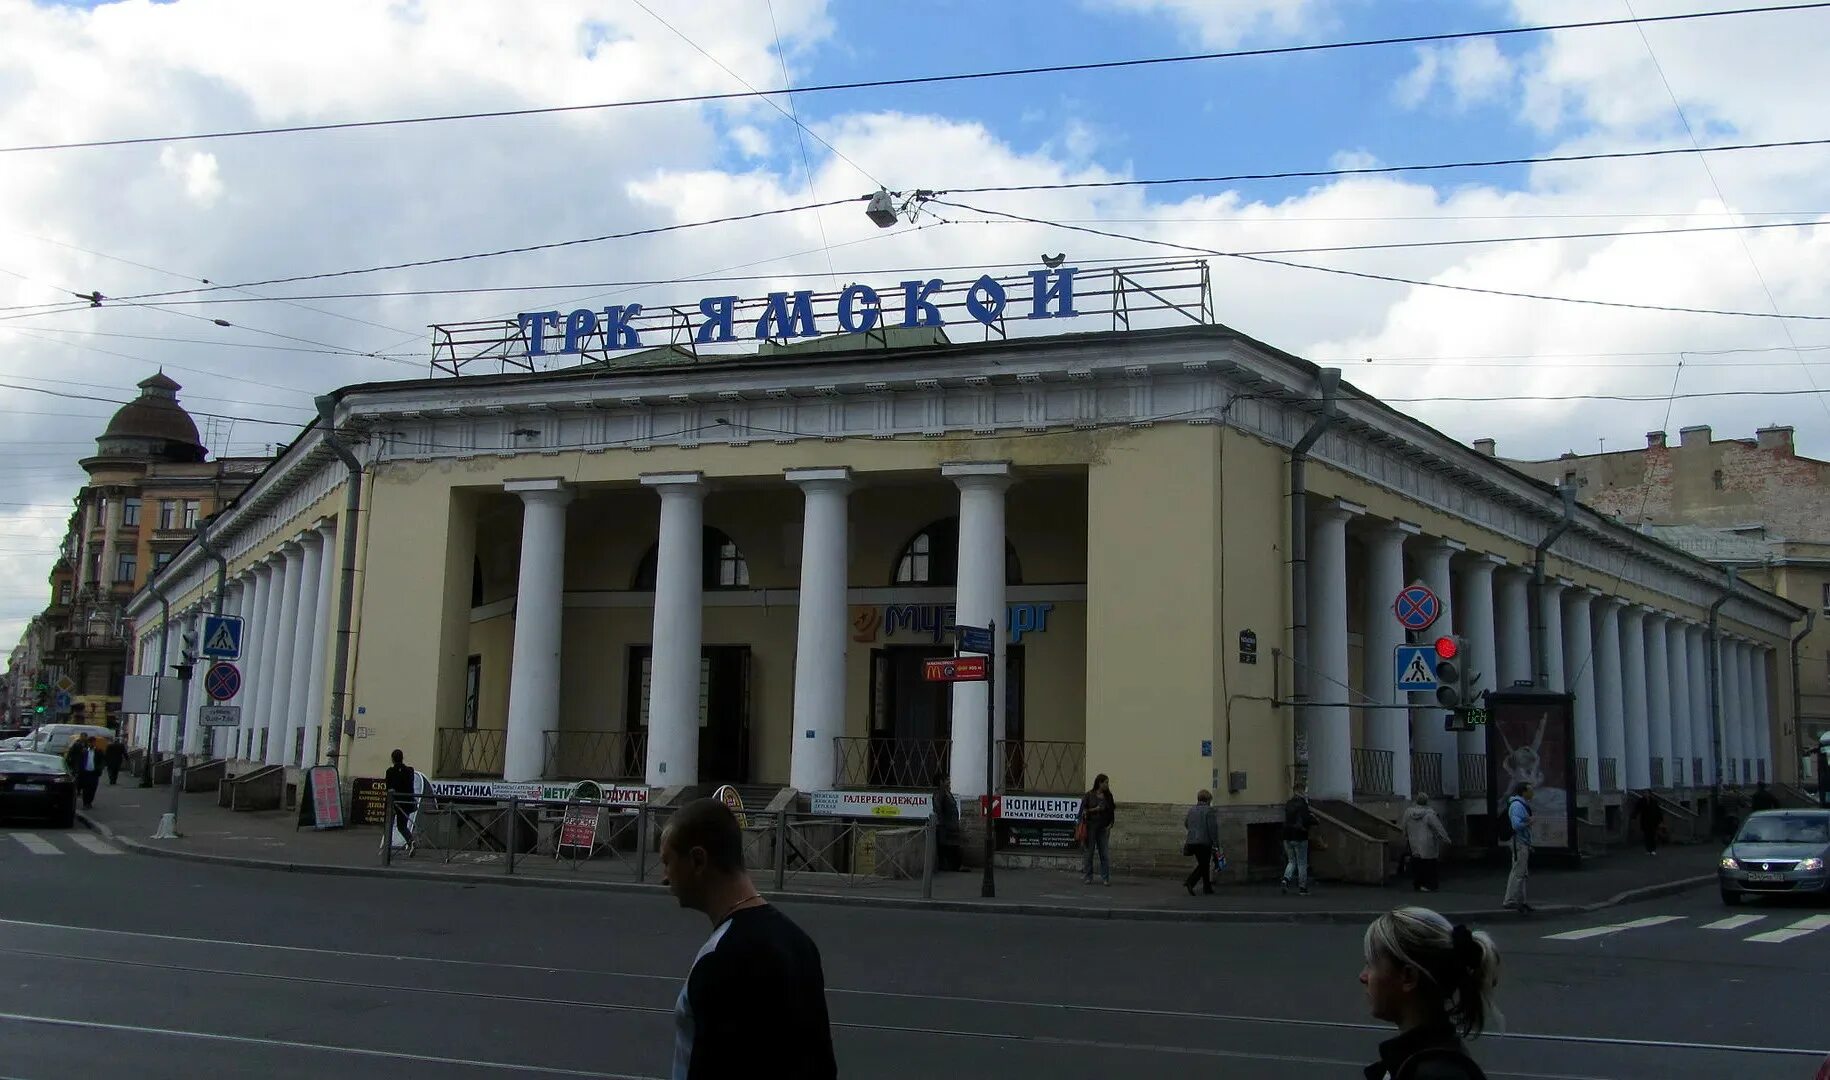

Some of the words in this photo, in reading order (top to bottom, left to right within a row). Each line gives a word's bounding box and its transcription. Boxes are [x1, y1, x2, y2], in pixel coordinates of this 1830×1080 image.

[517, 302, 644, 356] ТРК
[694, 253, 1080, 344] ЯМСКОЙ
[432, 784, 492, 796] САНТЕХНИКА
[544, 787, 573, 799] МЕТИ
[602, 789, 647, 803] ОДУКТЫ
[843, 794, 883, 804] ГАЛЕРЕЯ
[885, 796, 927, 806] ОДЕЖДЫ
[1006, 799, 1078, 812] КОПИЦЕНТР
